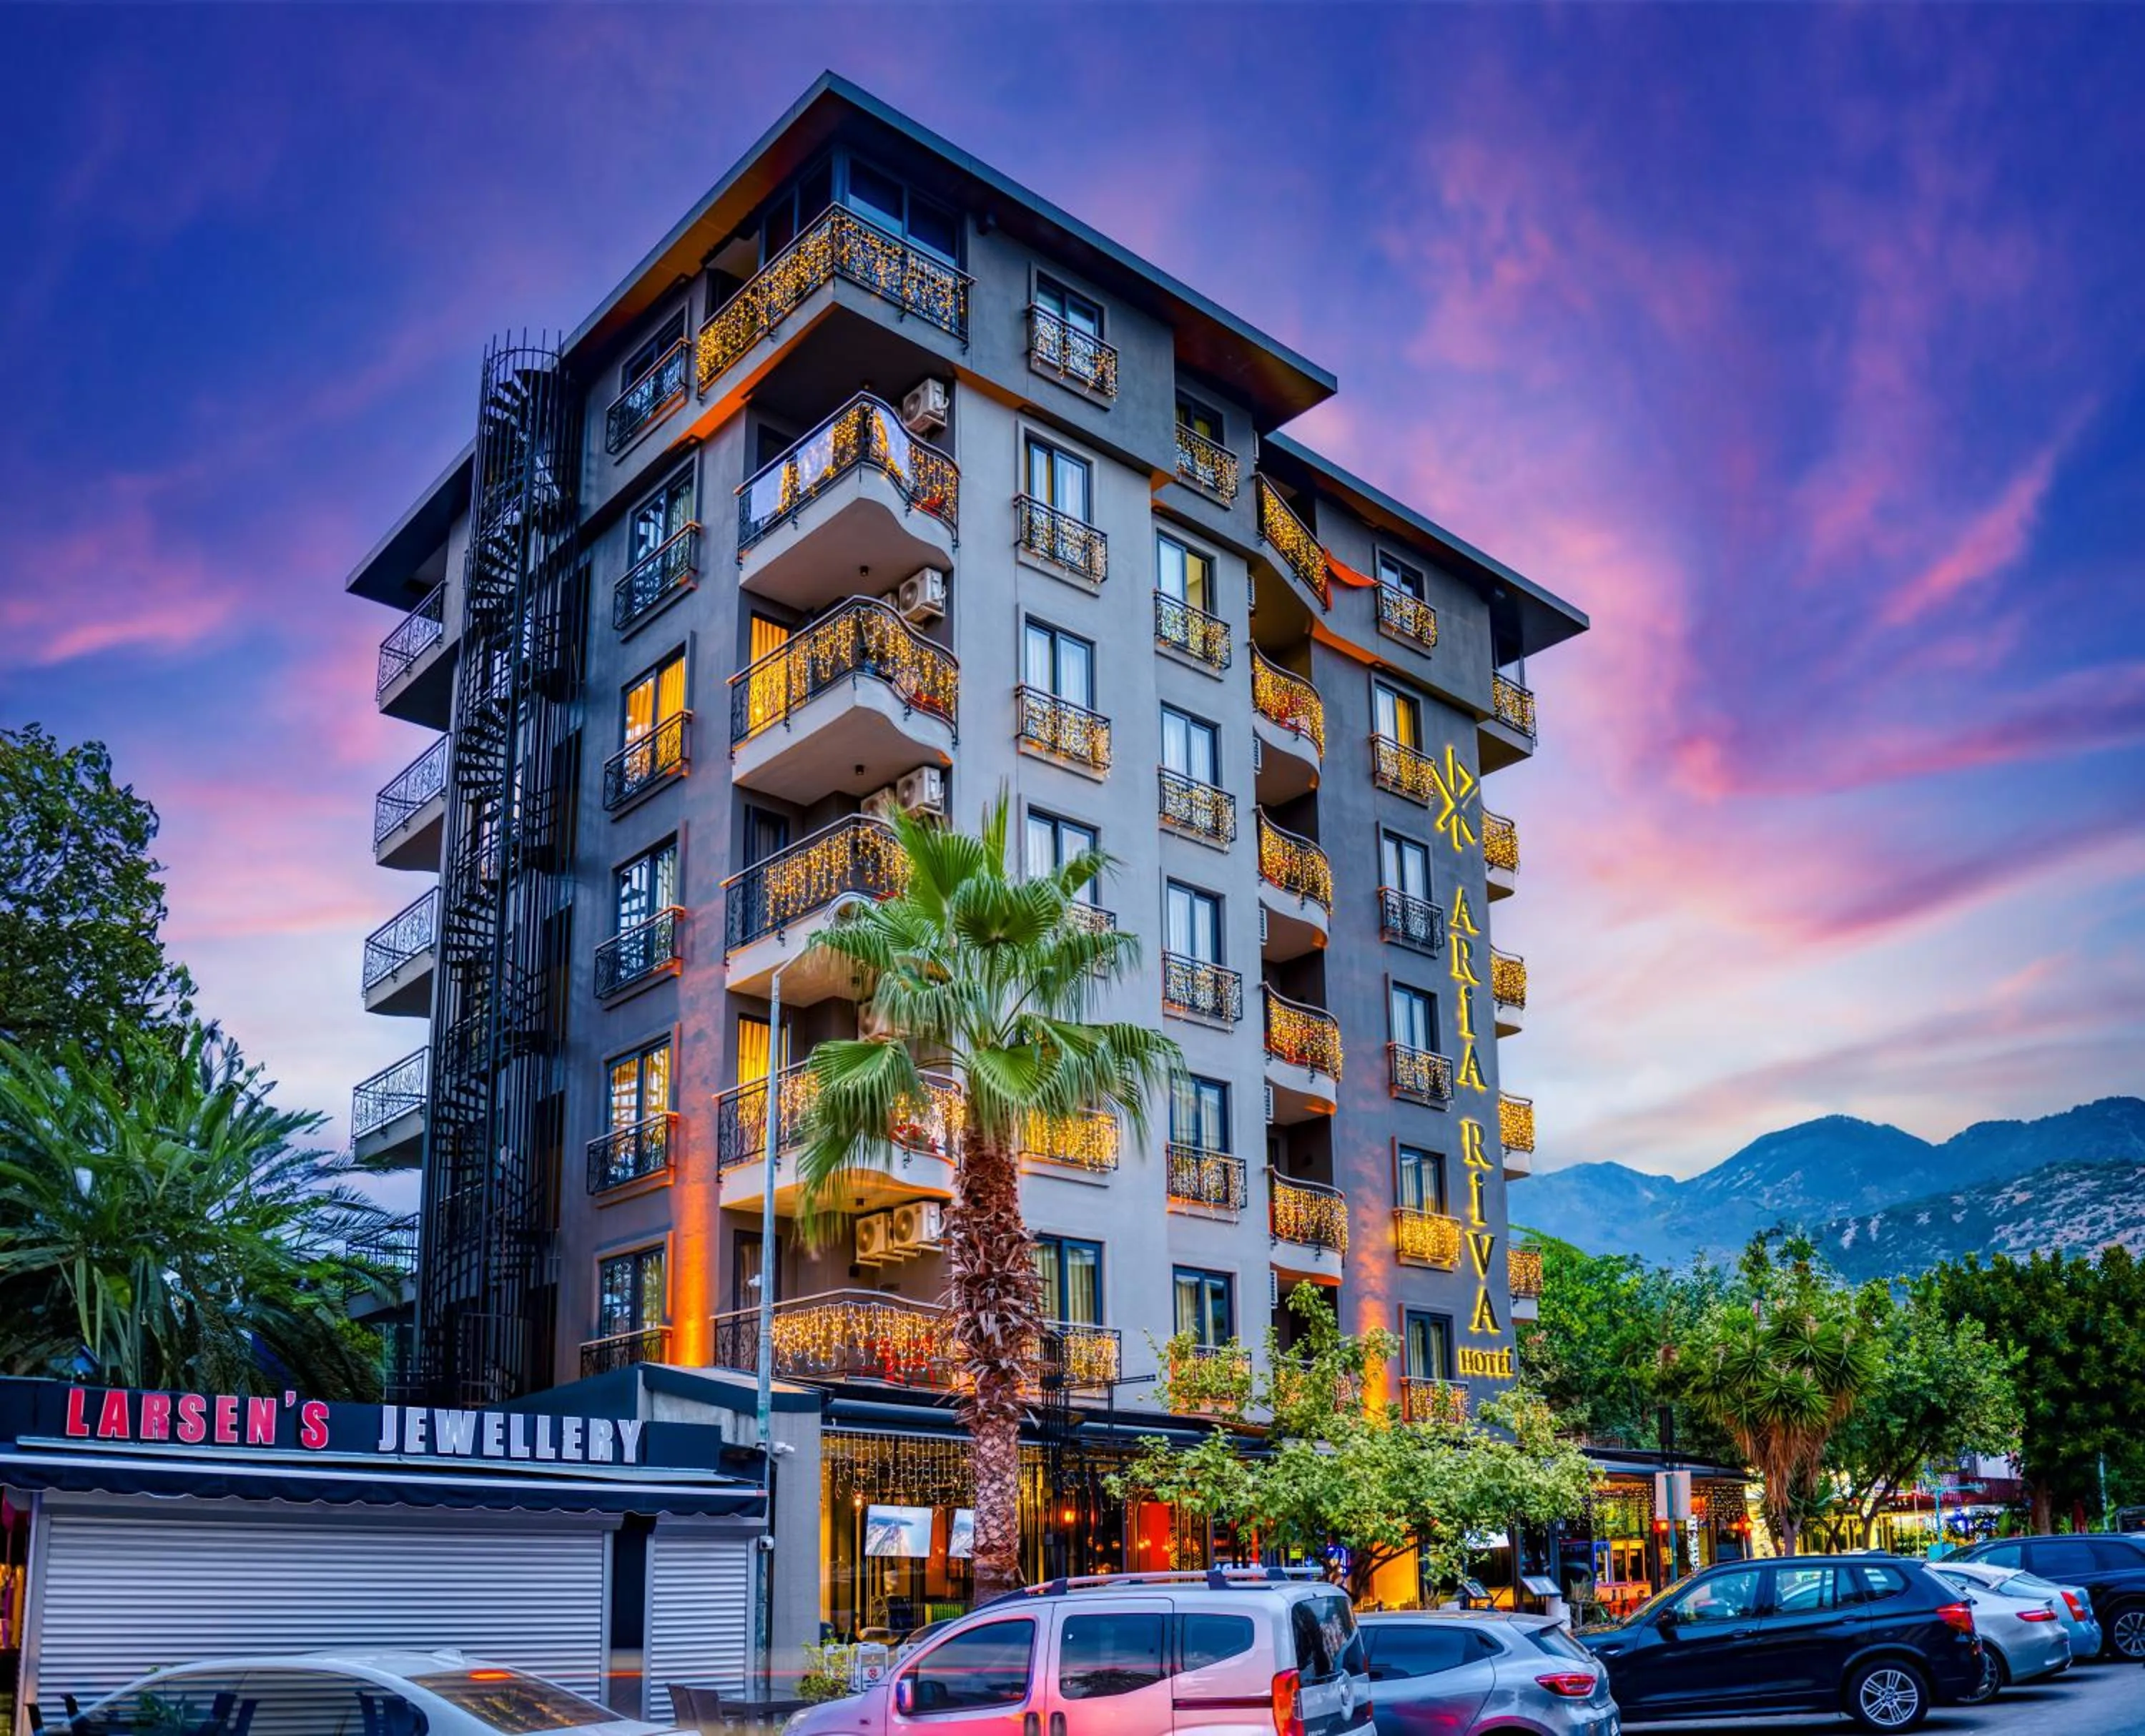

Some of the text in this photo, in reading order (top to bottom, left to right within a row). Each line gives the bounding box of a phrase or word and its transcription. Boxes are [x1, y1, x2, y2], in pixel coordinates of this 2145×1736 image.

[1458, 1347, 1514, 1376] HOTEL
[66, 1387, 643, 1463] LARSEN'S JEWELLERY
